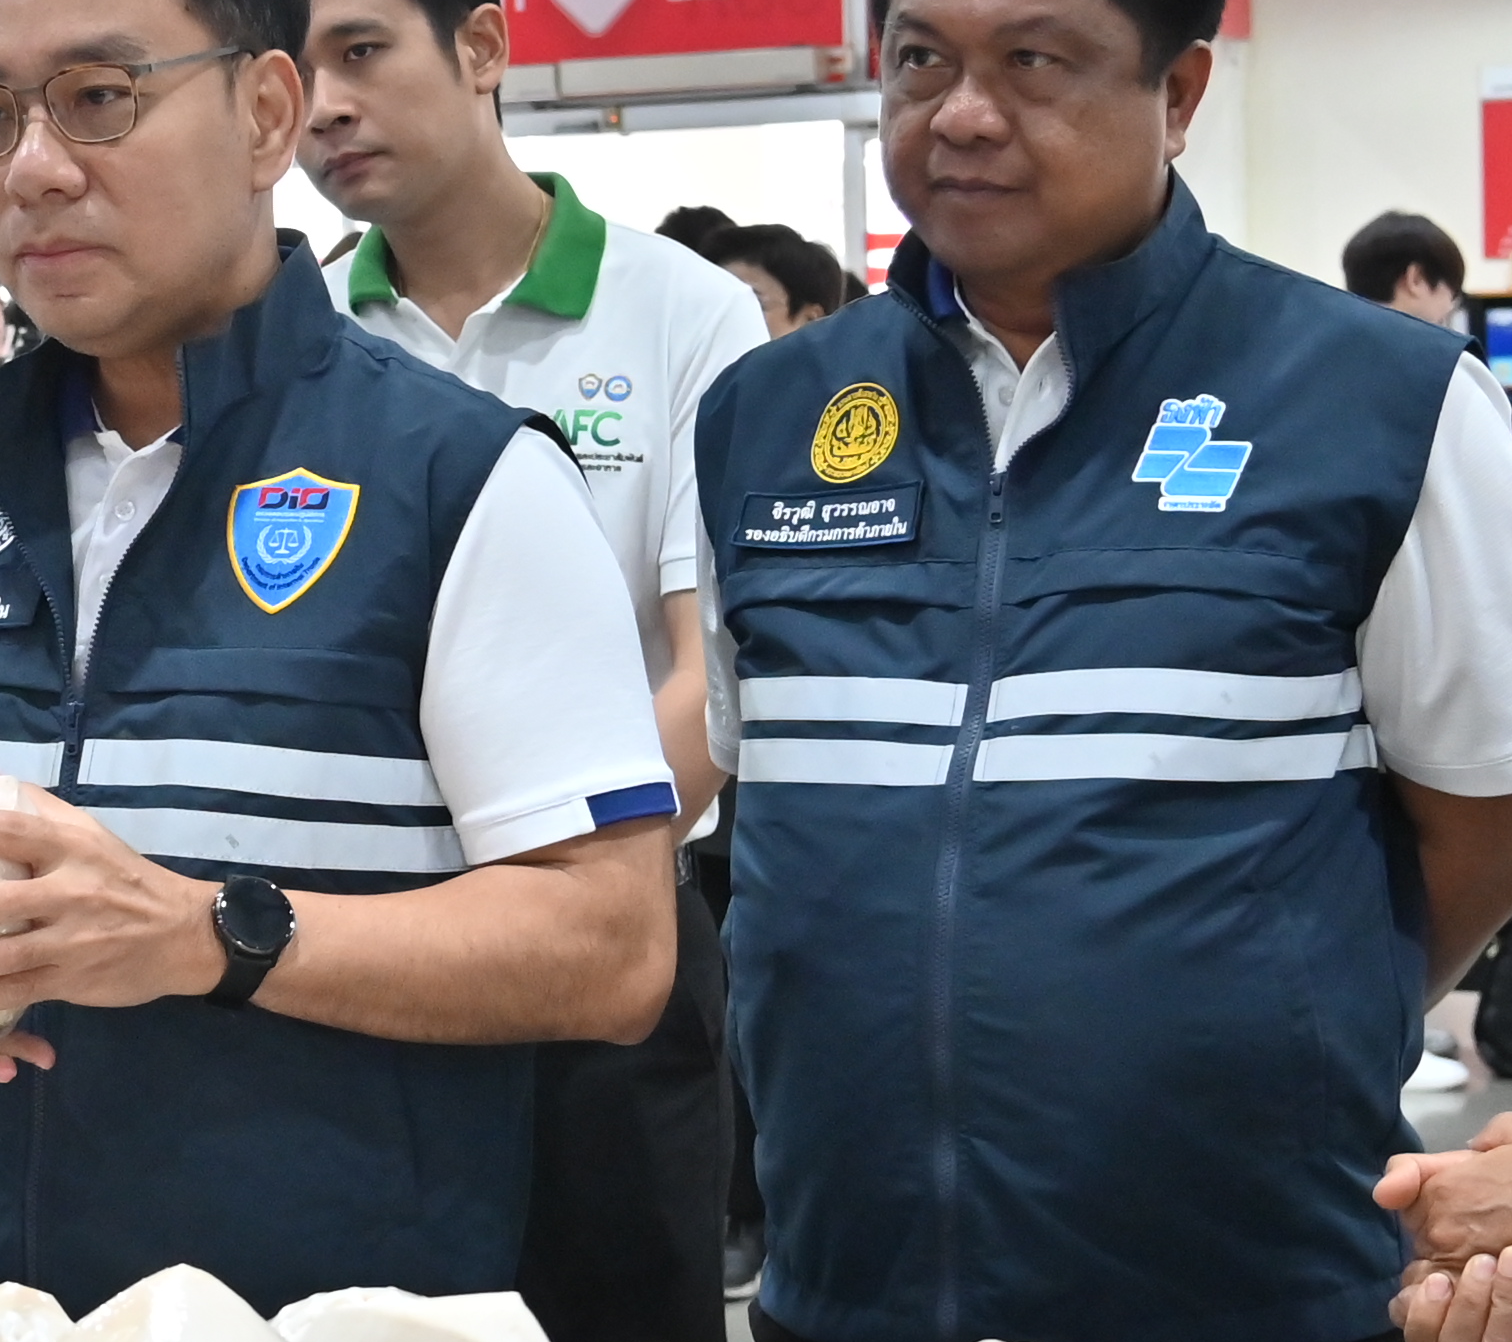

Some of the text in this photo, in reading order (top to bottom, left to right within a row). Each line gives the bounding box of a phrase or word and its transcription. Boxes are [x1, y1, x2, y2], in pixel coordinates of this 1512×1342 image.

[1160, 396, 1223, 427] ธงฟ้า
[745, 515, 908, 544] รองอธิบดีกรมการค้าภายใน
